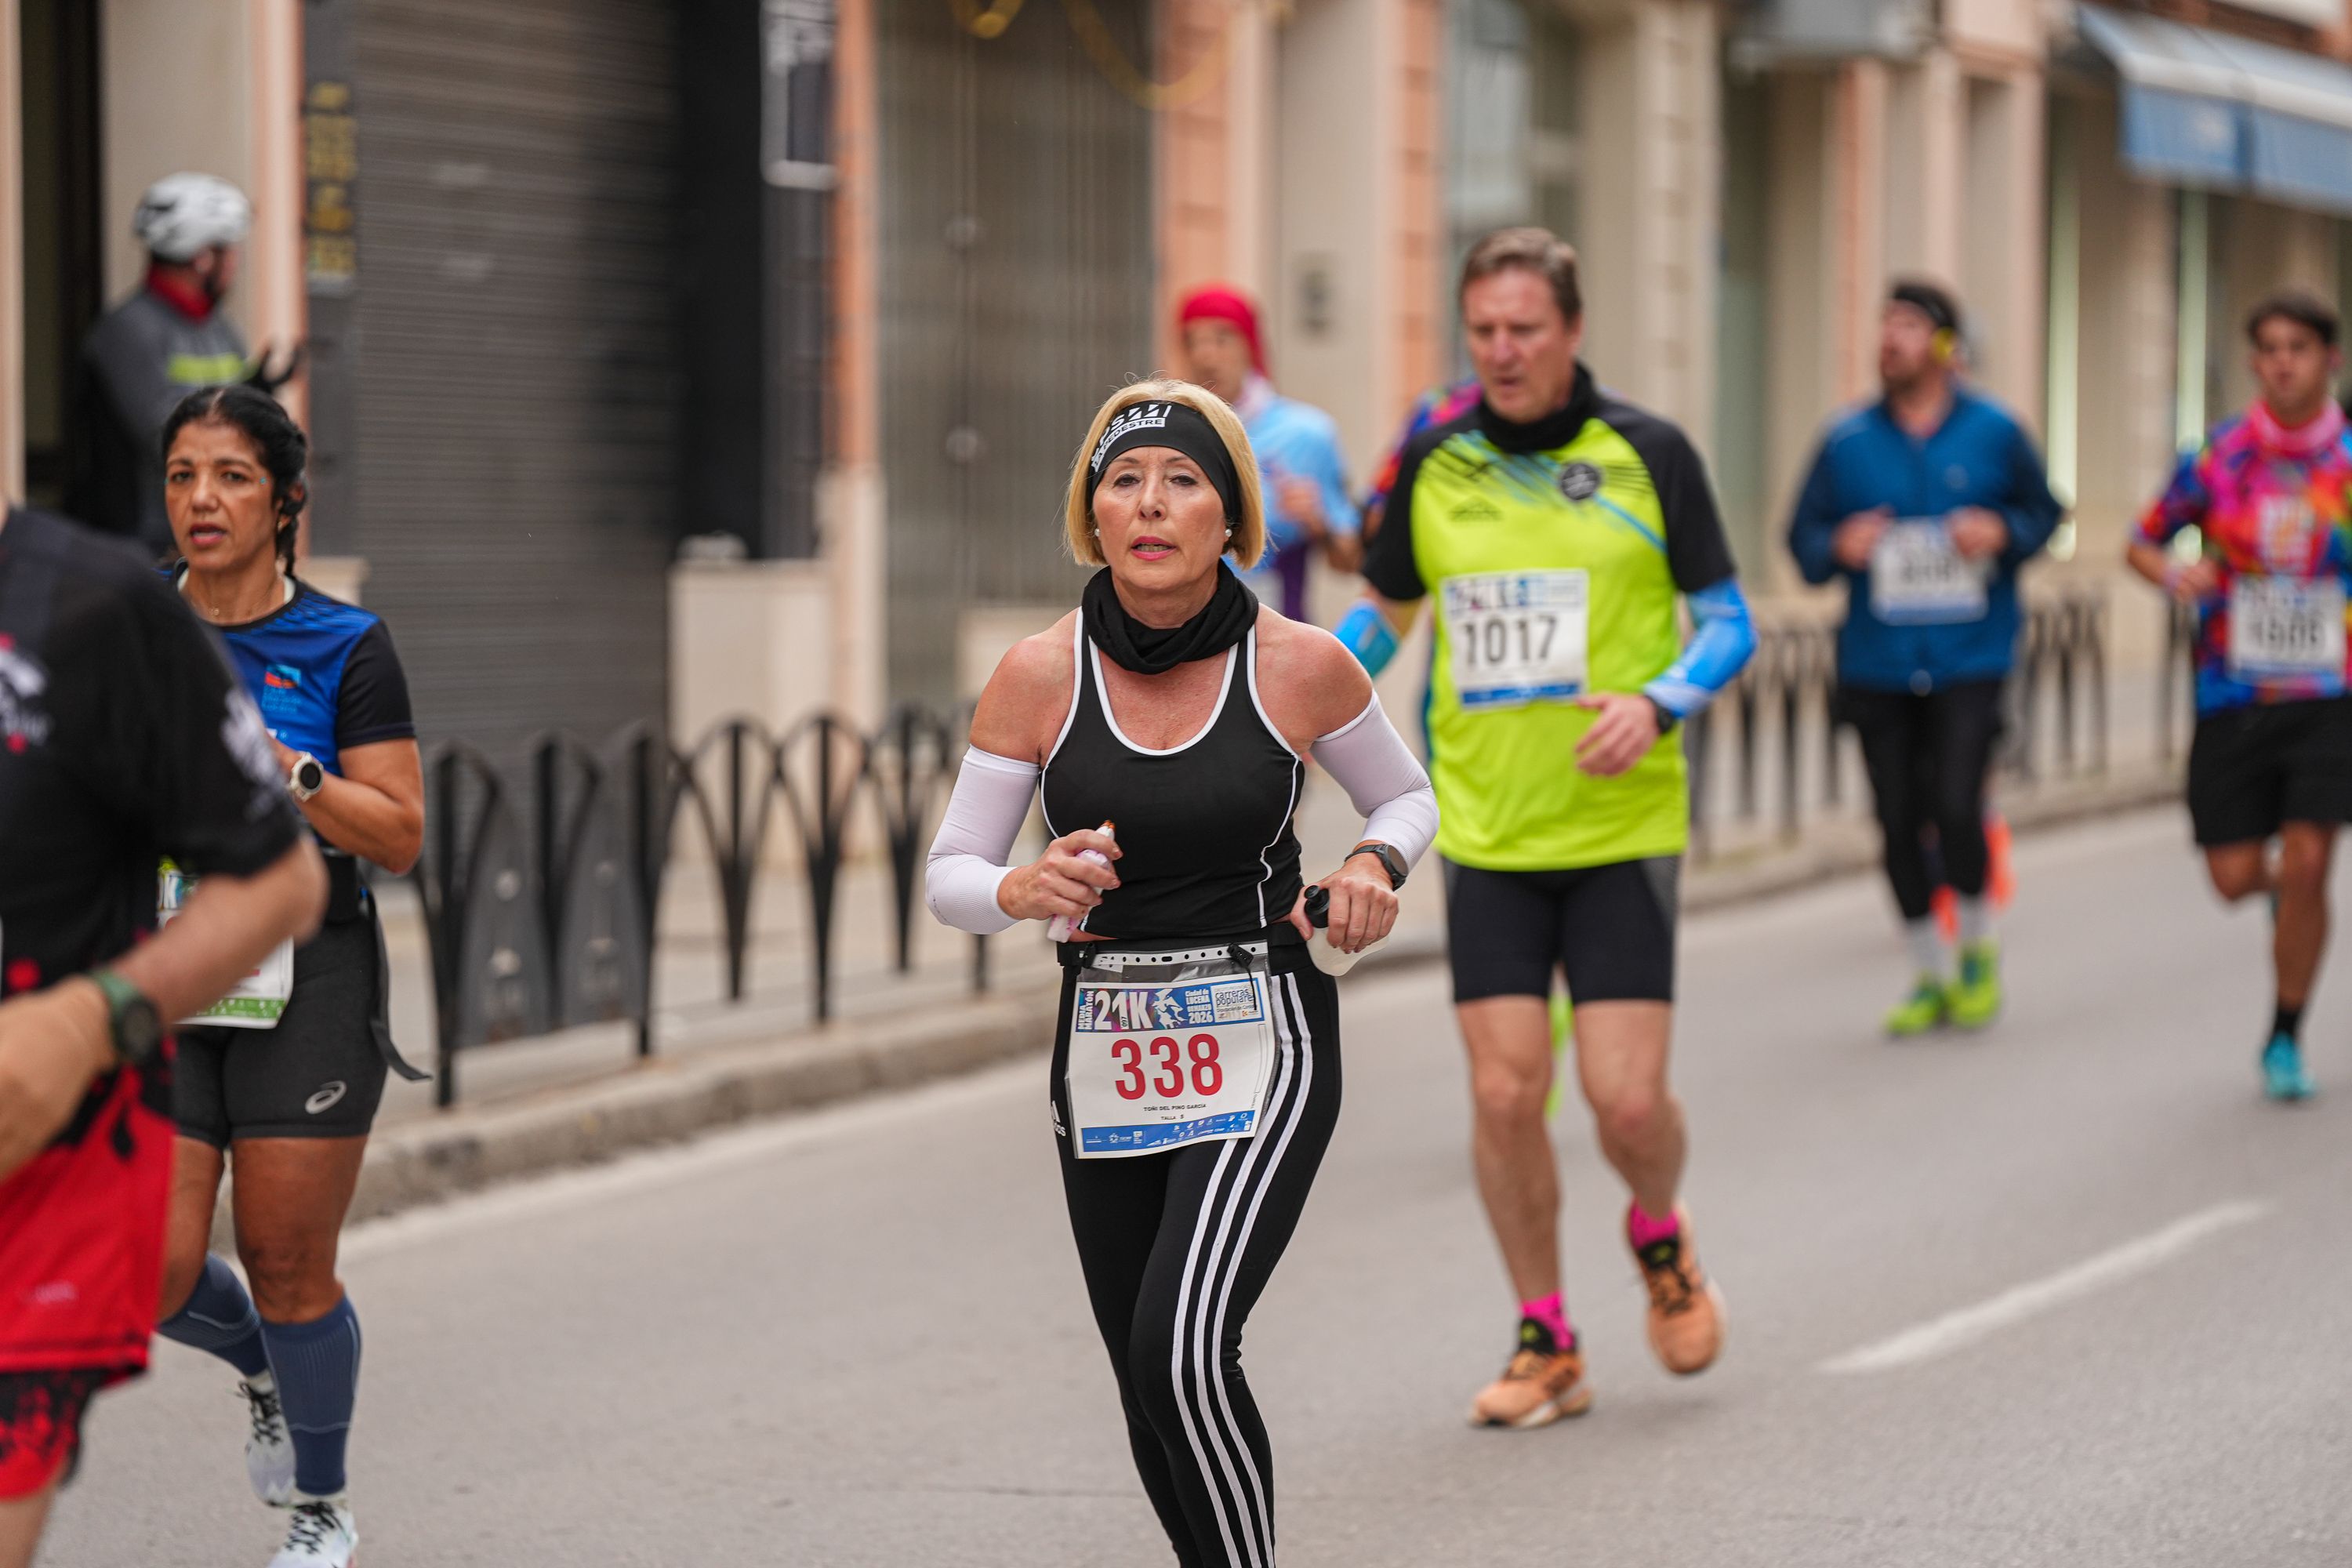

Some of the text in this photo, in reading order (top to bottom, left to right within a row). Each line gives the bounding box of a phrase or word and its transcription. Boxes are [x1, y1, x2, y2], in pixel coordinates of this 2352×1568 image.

[1104, 419, 1162, 450] PEDESTRE
[1464, 615, 1556, 666] 1017
[1185, 994, 1210, 1005] LUCENA
[1215, 989, 1249, 1000] carreras
[1216, 994, 1256, 1007] populare
[1077, 1004, 1086, 1029] MEDIA
[1094, 990, 1153, 1030] 21K
[1188, 1011, 1214, 1024] 2026
[1111, 1033, 1223, 1100] 338
